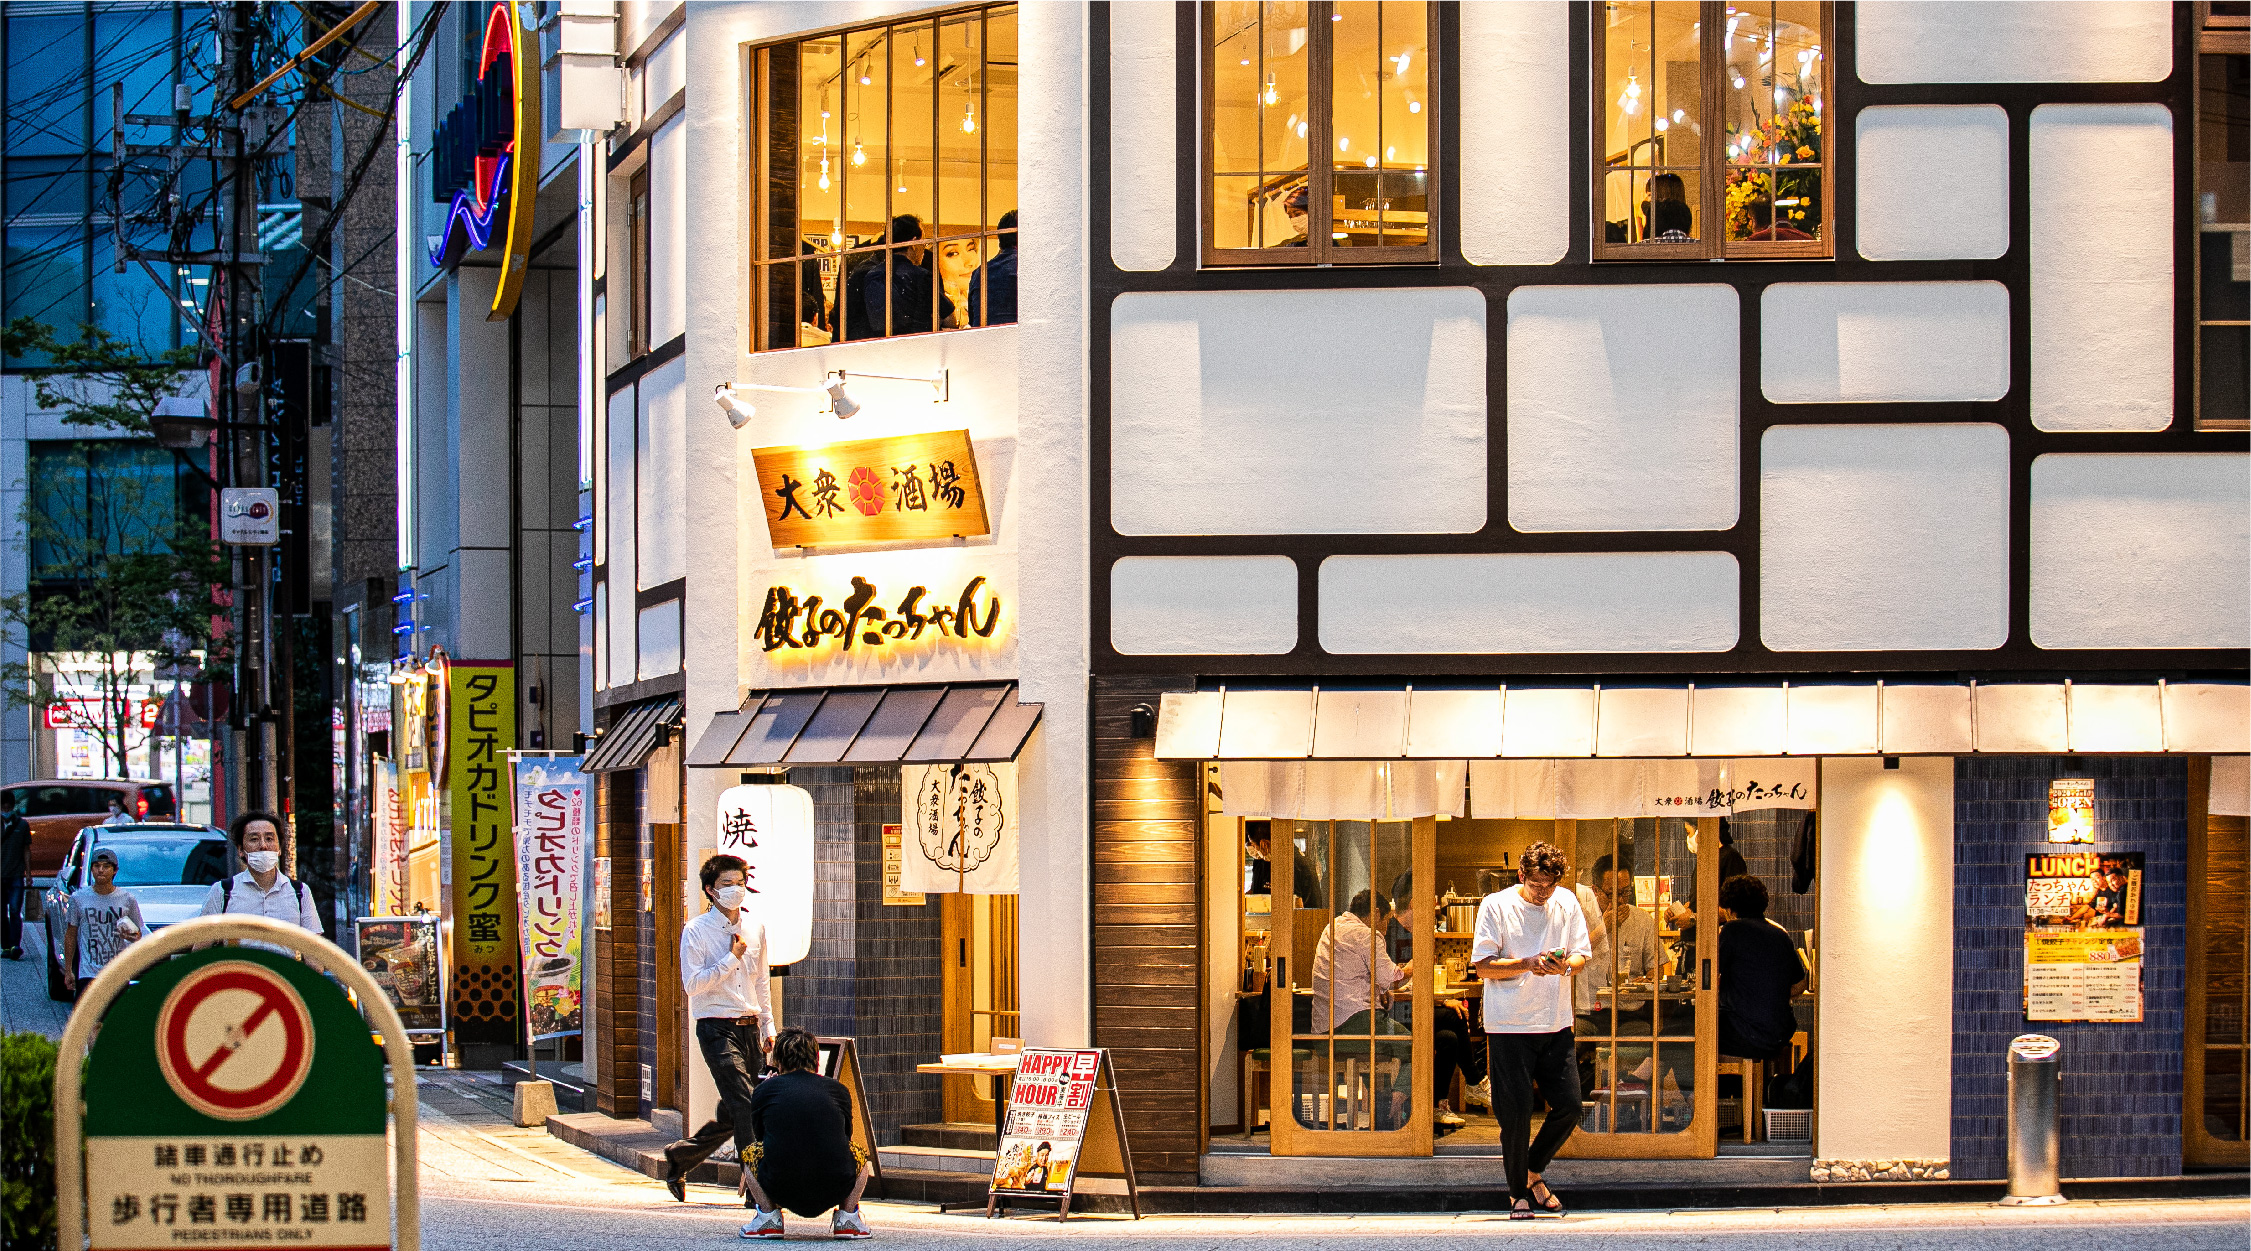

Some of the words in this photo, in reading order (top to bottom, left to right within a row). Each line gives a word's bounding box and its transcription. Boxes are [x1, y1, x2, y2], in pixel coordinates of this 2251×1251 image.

[775, 468, 846, 521] 大衆
[891, 460, 966, 512] 酒場
[754, 576, 1000, 652] 餃子のたっちゃん
[466, 674, 502, 942] タピオカドリンク蜜
[928, 780, 941, 837] 大衆酒場
[969, 778, 988, 839] 餃子の
[2057, 797, 2092, 808] OPEN
[2029, 857, 2100, 877] LUNCH
[2028, 879, 2091, 892] たっちゃん
[2029, 894, 2069, 907] ランチ
[1021, 1055, 1073, 1075] HAPPY
[1067, 1054, 1096, 1108] 早割
[1014, 1084, 1058, 1105] HOUR
[154, 1142, 324, 1168] 諸車通行止め
[195, 1172, 313, 1185] THOROUGHFARE
[111, 1193, 367, 1226] 歩行者専用道路
[172, 1228, 272, 1241] PEDESTRIANS
[277, 1228, 314, 1240] ONLY
